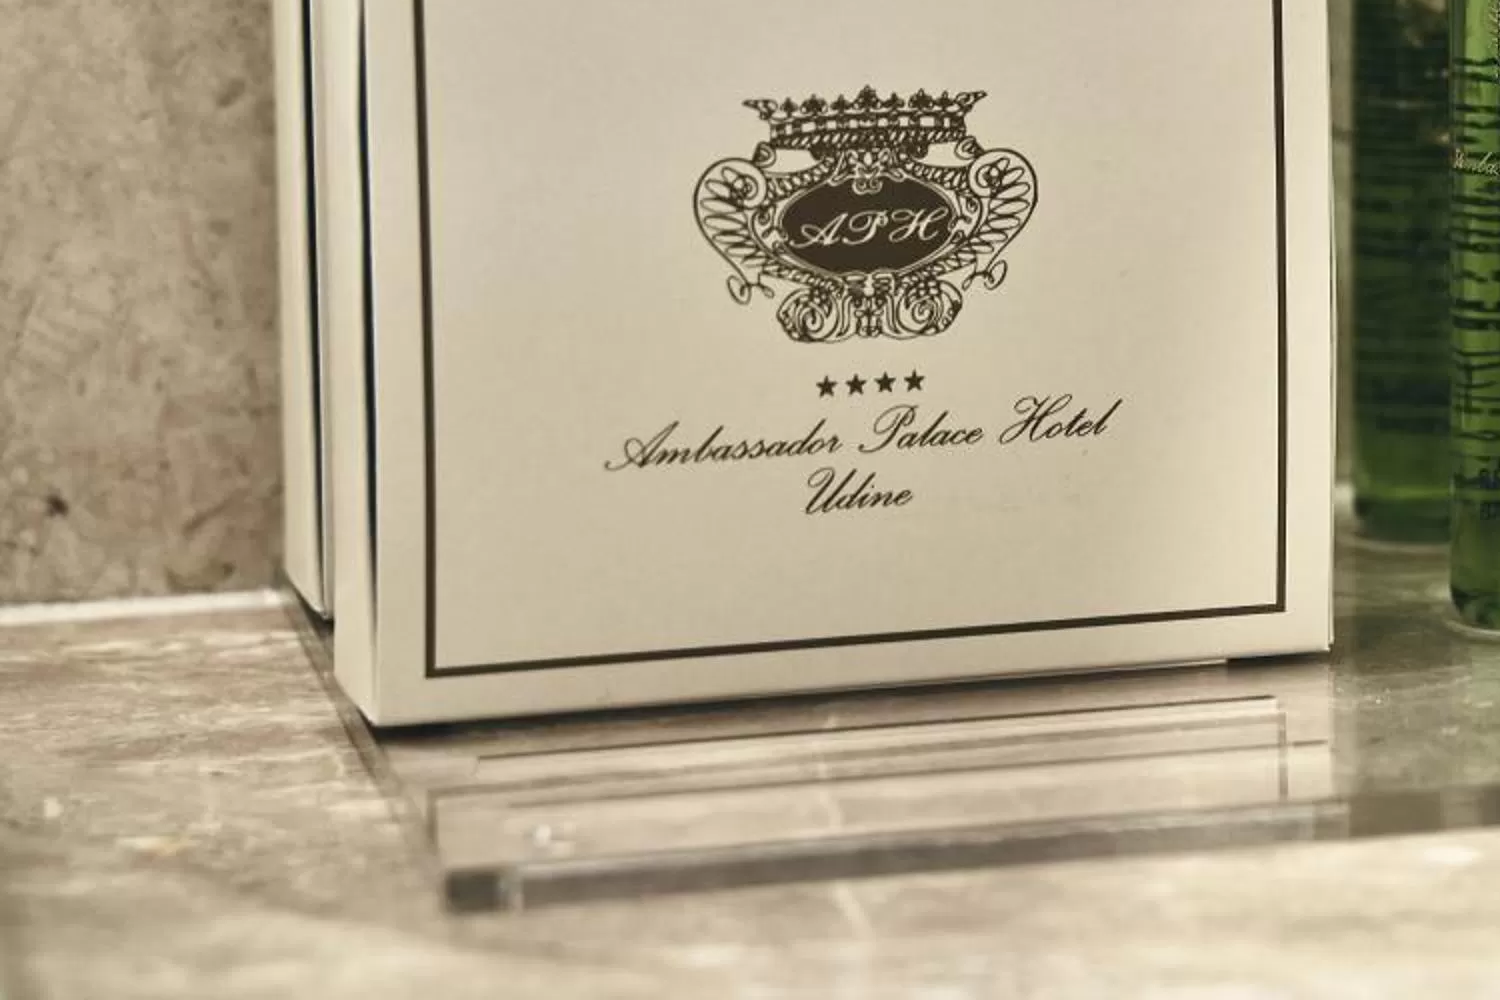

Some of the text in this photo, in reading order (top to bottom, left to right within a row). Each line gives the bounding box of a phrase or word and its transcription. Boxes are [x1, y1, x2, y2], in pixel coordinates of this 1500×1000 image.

[604, 394, 1123, 470] Ambassador Palace Hotel
[804, 466, 913, 515] Udine
